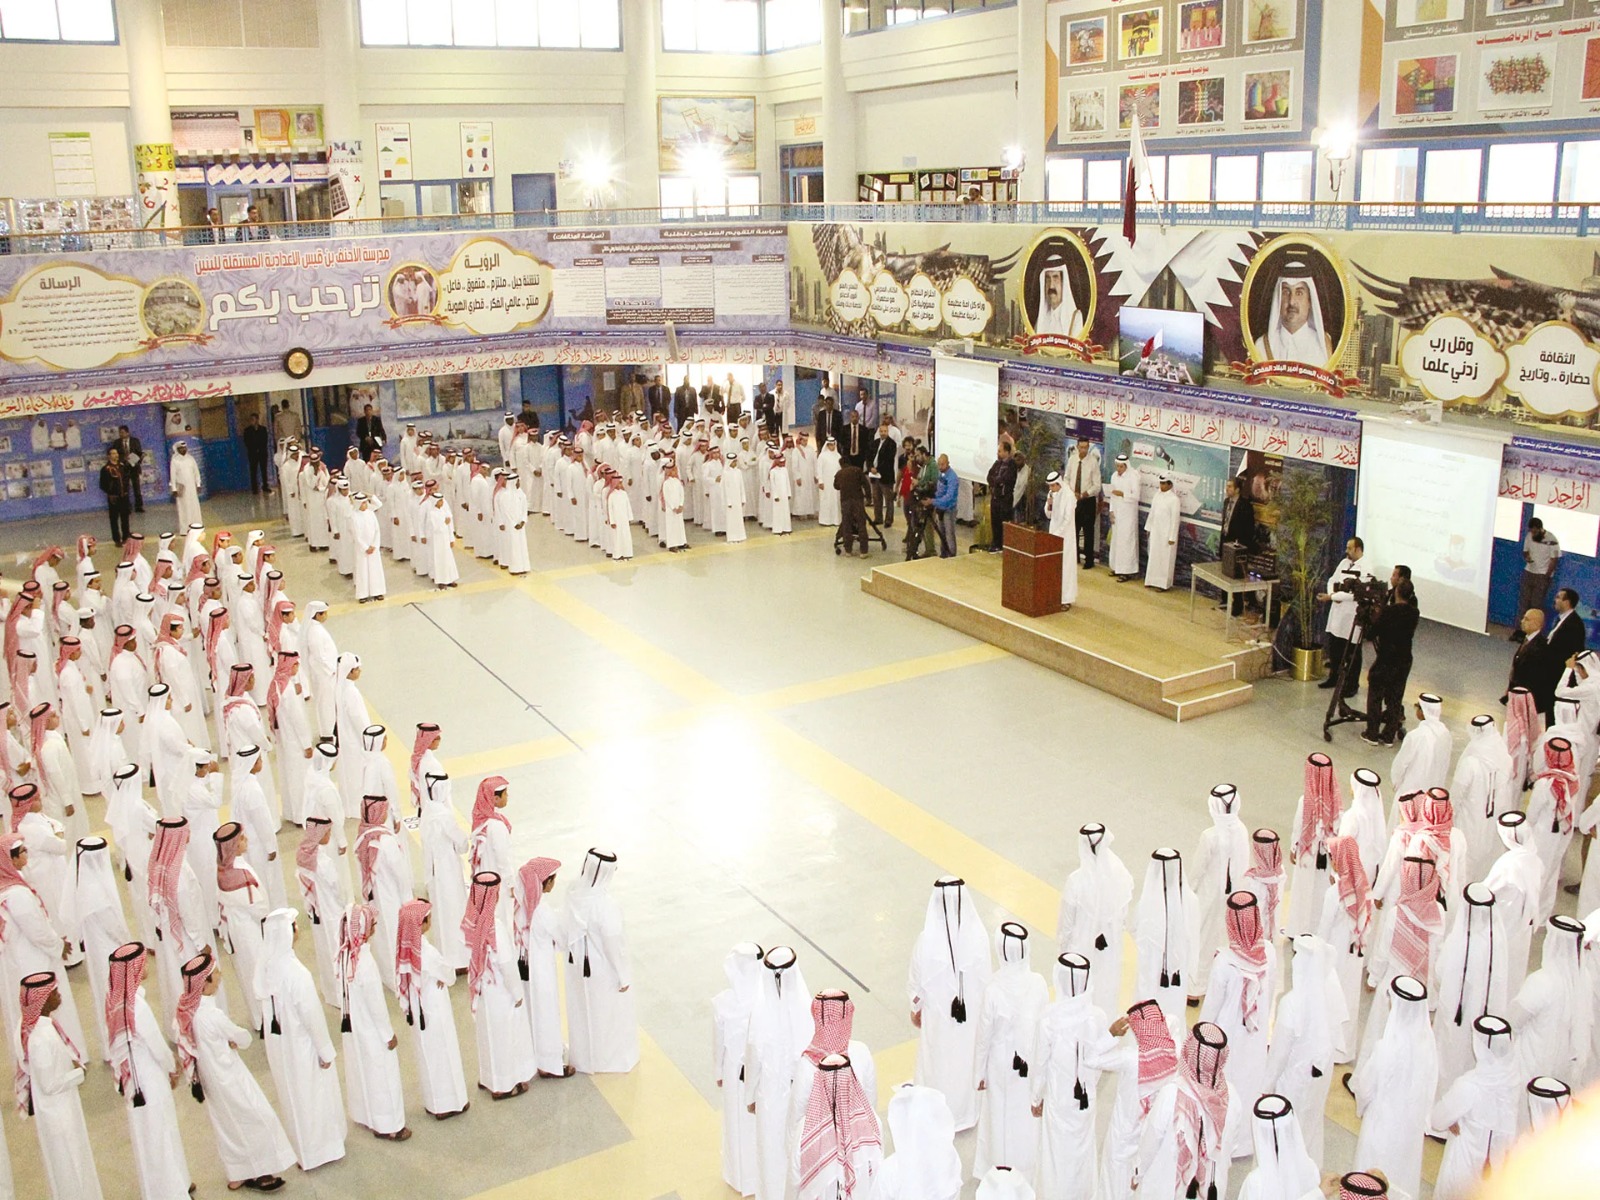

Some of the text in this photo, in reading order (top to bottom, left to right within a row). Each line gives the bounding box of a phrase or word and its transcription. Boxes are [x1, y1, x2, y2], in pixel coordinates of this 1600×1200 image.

[222, 252, 264, 270] المستقلة
[302, 250, 324, 268] قيس
[326, 253, 334, 267] بن
[363, 247, 390, 264] مدرسة
[195, 256, 221, 275] للبنين
[40, 276, 82, 292] الرسالة
[209, 274, 382, 331] ترحب بكم
[1430, 336, 1474, 356] وقل رب
[1540, 350, 1576, 366] الثقافة
[1299, 368, 1316, 377] السمو
[1316, 373, 1334, 385] صاحب
[1422, 356, 1478, 384] زدني علما
[1519, 366, 1590, 386] حضارة وتاريخ
[1548, 480, 1590, 510] الواجد
